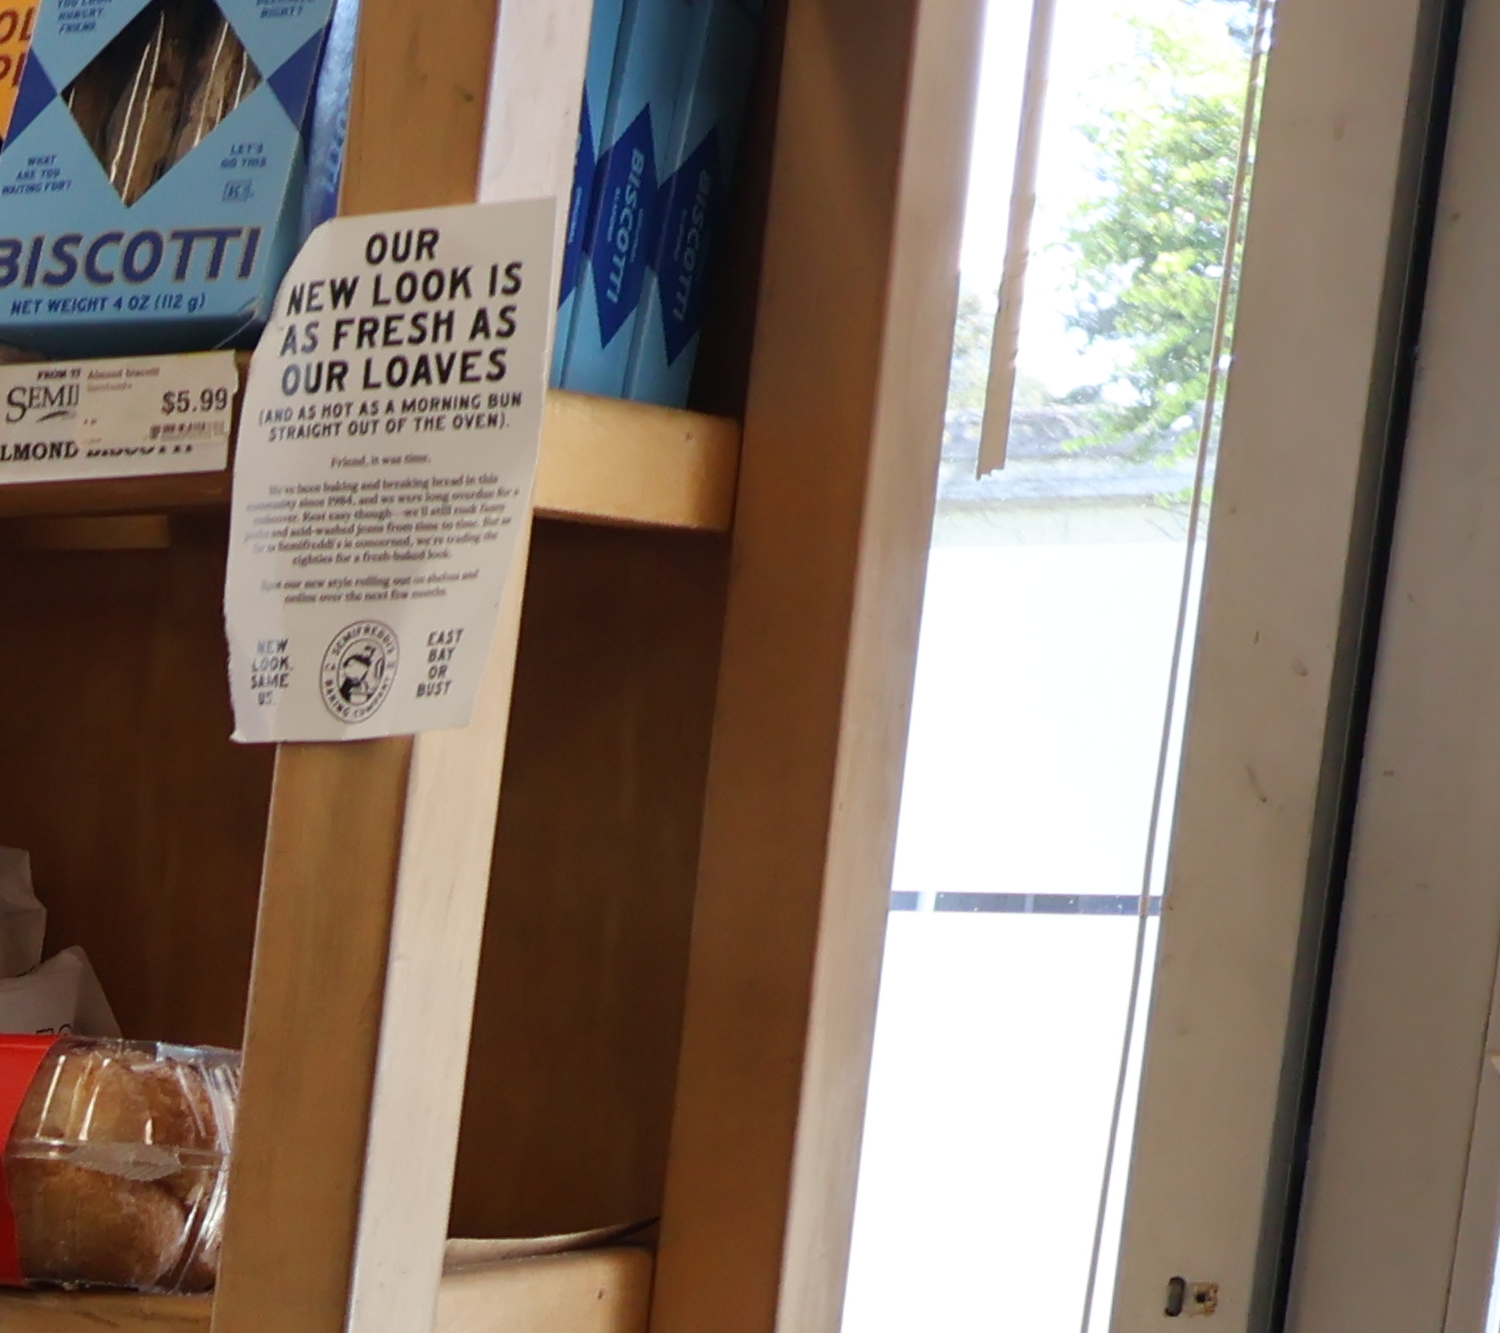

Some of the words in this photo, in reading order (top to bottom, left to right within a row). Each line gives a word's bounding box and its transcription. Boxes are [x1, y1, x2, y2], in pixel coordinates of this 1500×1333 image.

[365, 228, 439, 266] OUR
[11, 298, 45, 316] NET
[47, 296, 112, 313] WEIGHT
[115, 298, 125, 312] 4
[129, 295, 151, 311] OZ
[155, 293, 184, 312] (112
[186, 293, 206, 313] g)
[286, 275, 360, 317] NEW
[372, 266, 473, 308] LOOK
[489, 261, 523, 297] IS
[279, 321, 320, 357] AS
[332, 309, 455, 352] FRESH
[468, 305, 518, 342] AS
[281, 359, 349, 397] OUR
[362, 348, 508, 391] LOAVES
[161, 388, 229, 416] $5.99
[259, 407, 293, 426] (AND
[297, 405, 316, 421] AS
[322, 402, 353, 420] HOT
[359, 401, 380, 416] AS
[385, 400, 396, 413] A
[401, 393, 481, 413] MORNING
[488, 391, 522, 409] BUN
[268, 422, 342, 443] STRAIGHT
[348, 417, 378, 436] OUT
[385, 415, 405, 433] OF
[413, 415, 446, 432] THE
[452, 412, 511, 430] OVEN).
